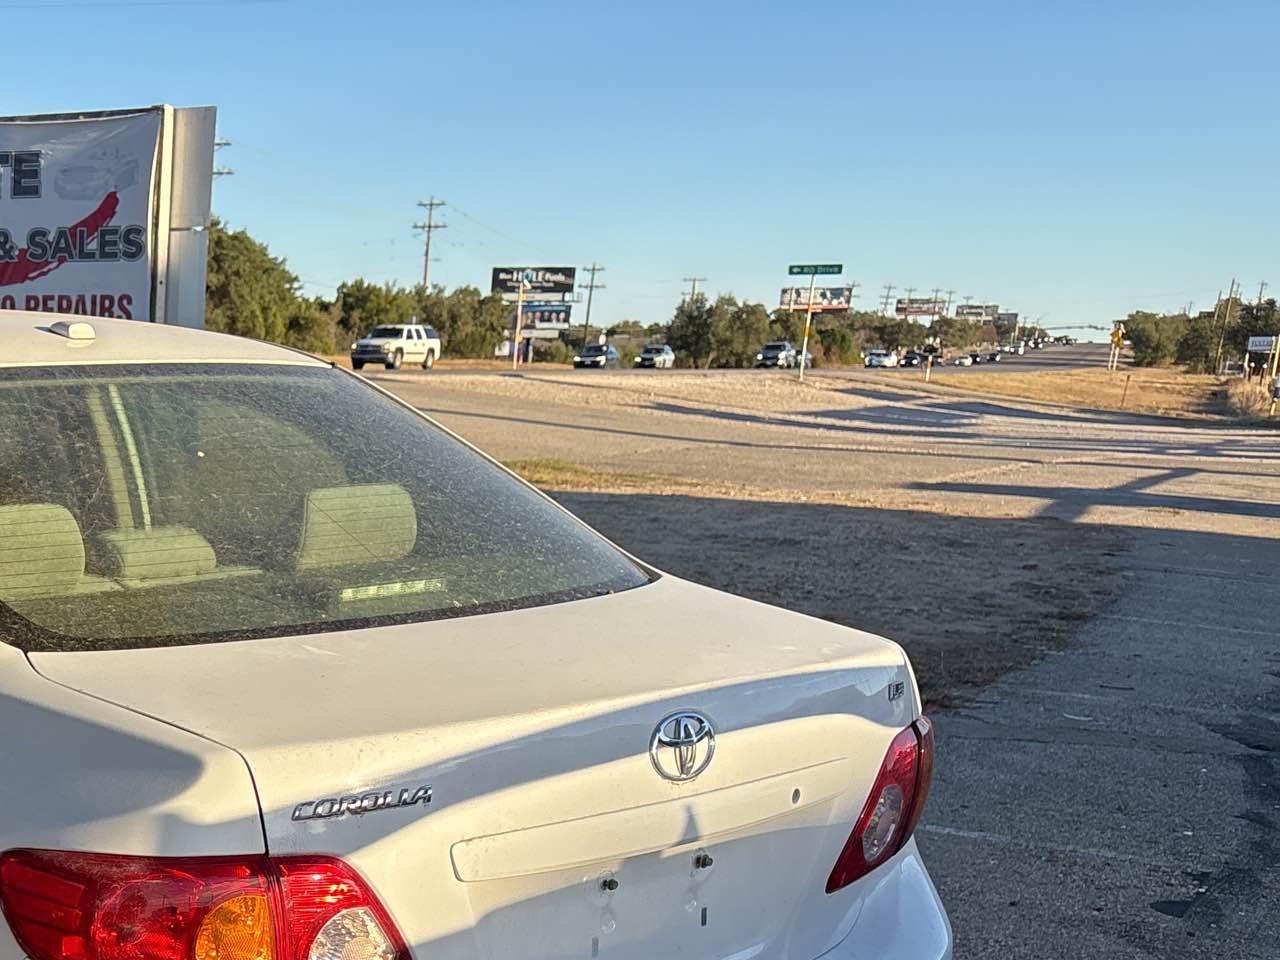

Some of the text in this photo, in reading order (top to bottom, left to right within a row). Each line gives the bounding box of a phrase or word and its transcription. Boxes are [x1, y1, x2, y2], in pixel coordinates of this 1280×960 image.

[25, 223, 148, 264] SALES
[25, 294, 134, 321] REPAIRS
[291, 784, 433, 822] COROLLA
